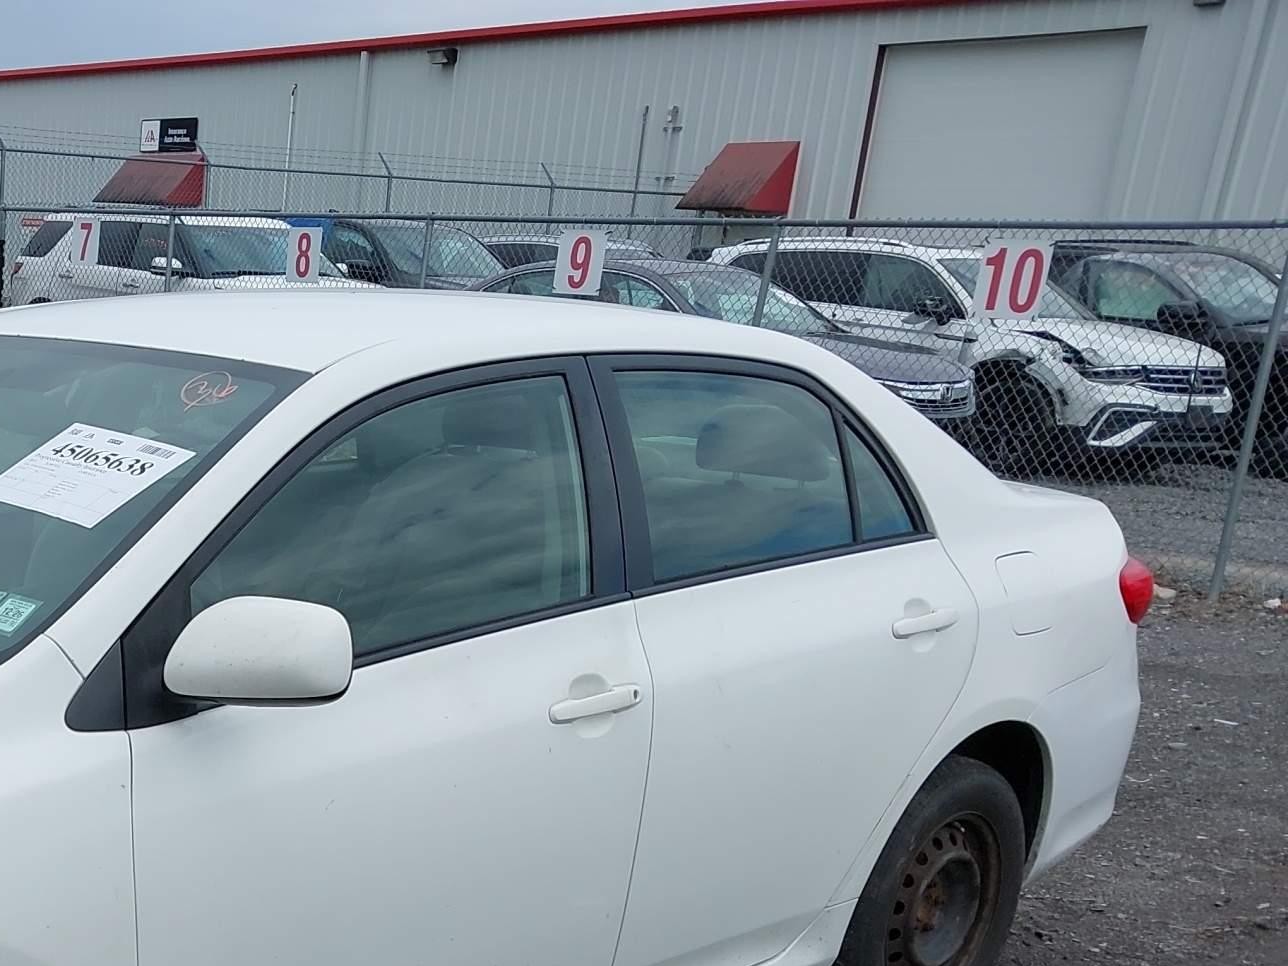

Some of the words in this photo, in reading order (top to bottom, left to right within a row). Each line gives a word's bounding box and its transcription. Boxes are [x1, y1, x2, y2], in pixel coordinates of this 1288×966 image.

[79, 223, 93, 261] 7
[295, 233, 310, 277] 8
[567, 236, 591, 289] 9
[985, 248, 1044, 314] 10
[51, 442, 154, 477] 45065638
